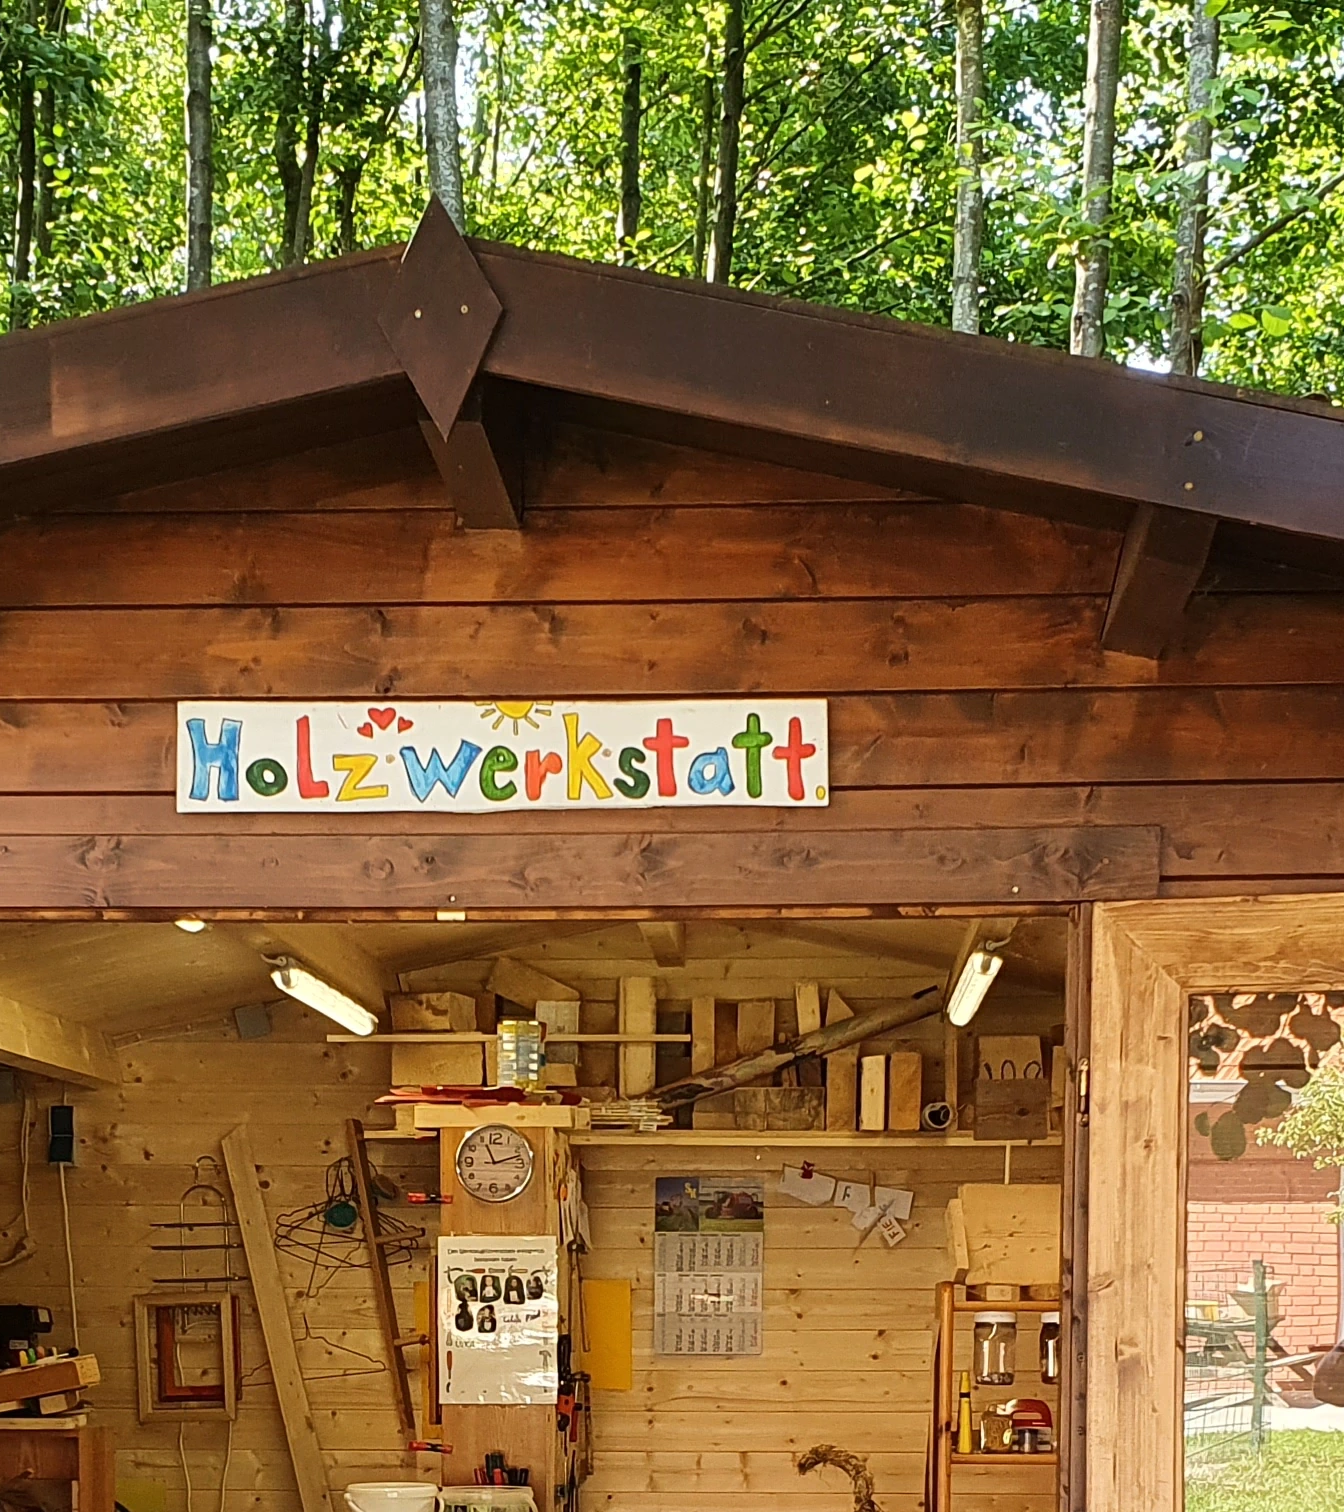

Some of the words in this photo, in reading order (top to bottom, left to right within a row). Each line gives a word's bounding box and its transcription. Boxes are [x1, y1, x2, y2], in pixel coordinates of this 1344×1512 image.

[489, 1132, 503, 1145] 12
[464, 1156, 474, 1168] 9
[514, 1158, 525, 1169] 3
[488, 1183, 498, 1194] 6
